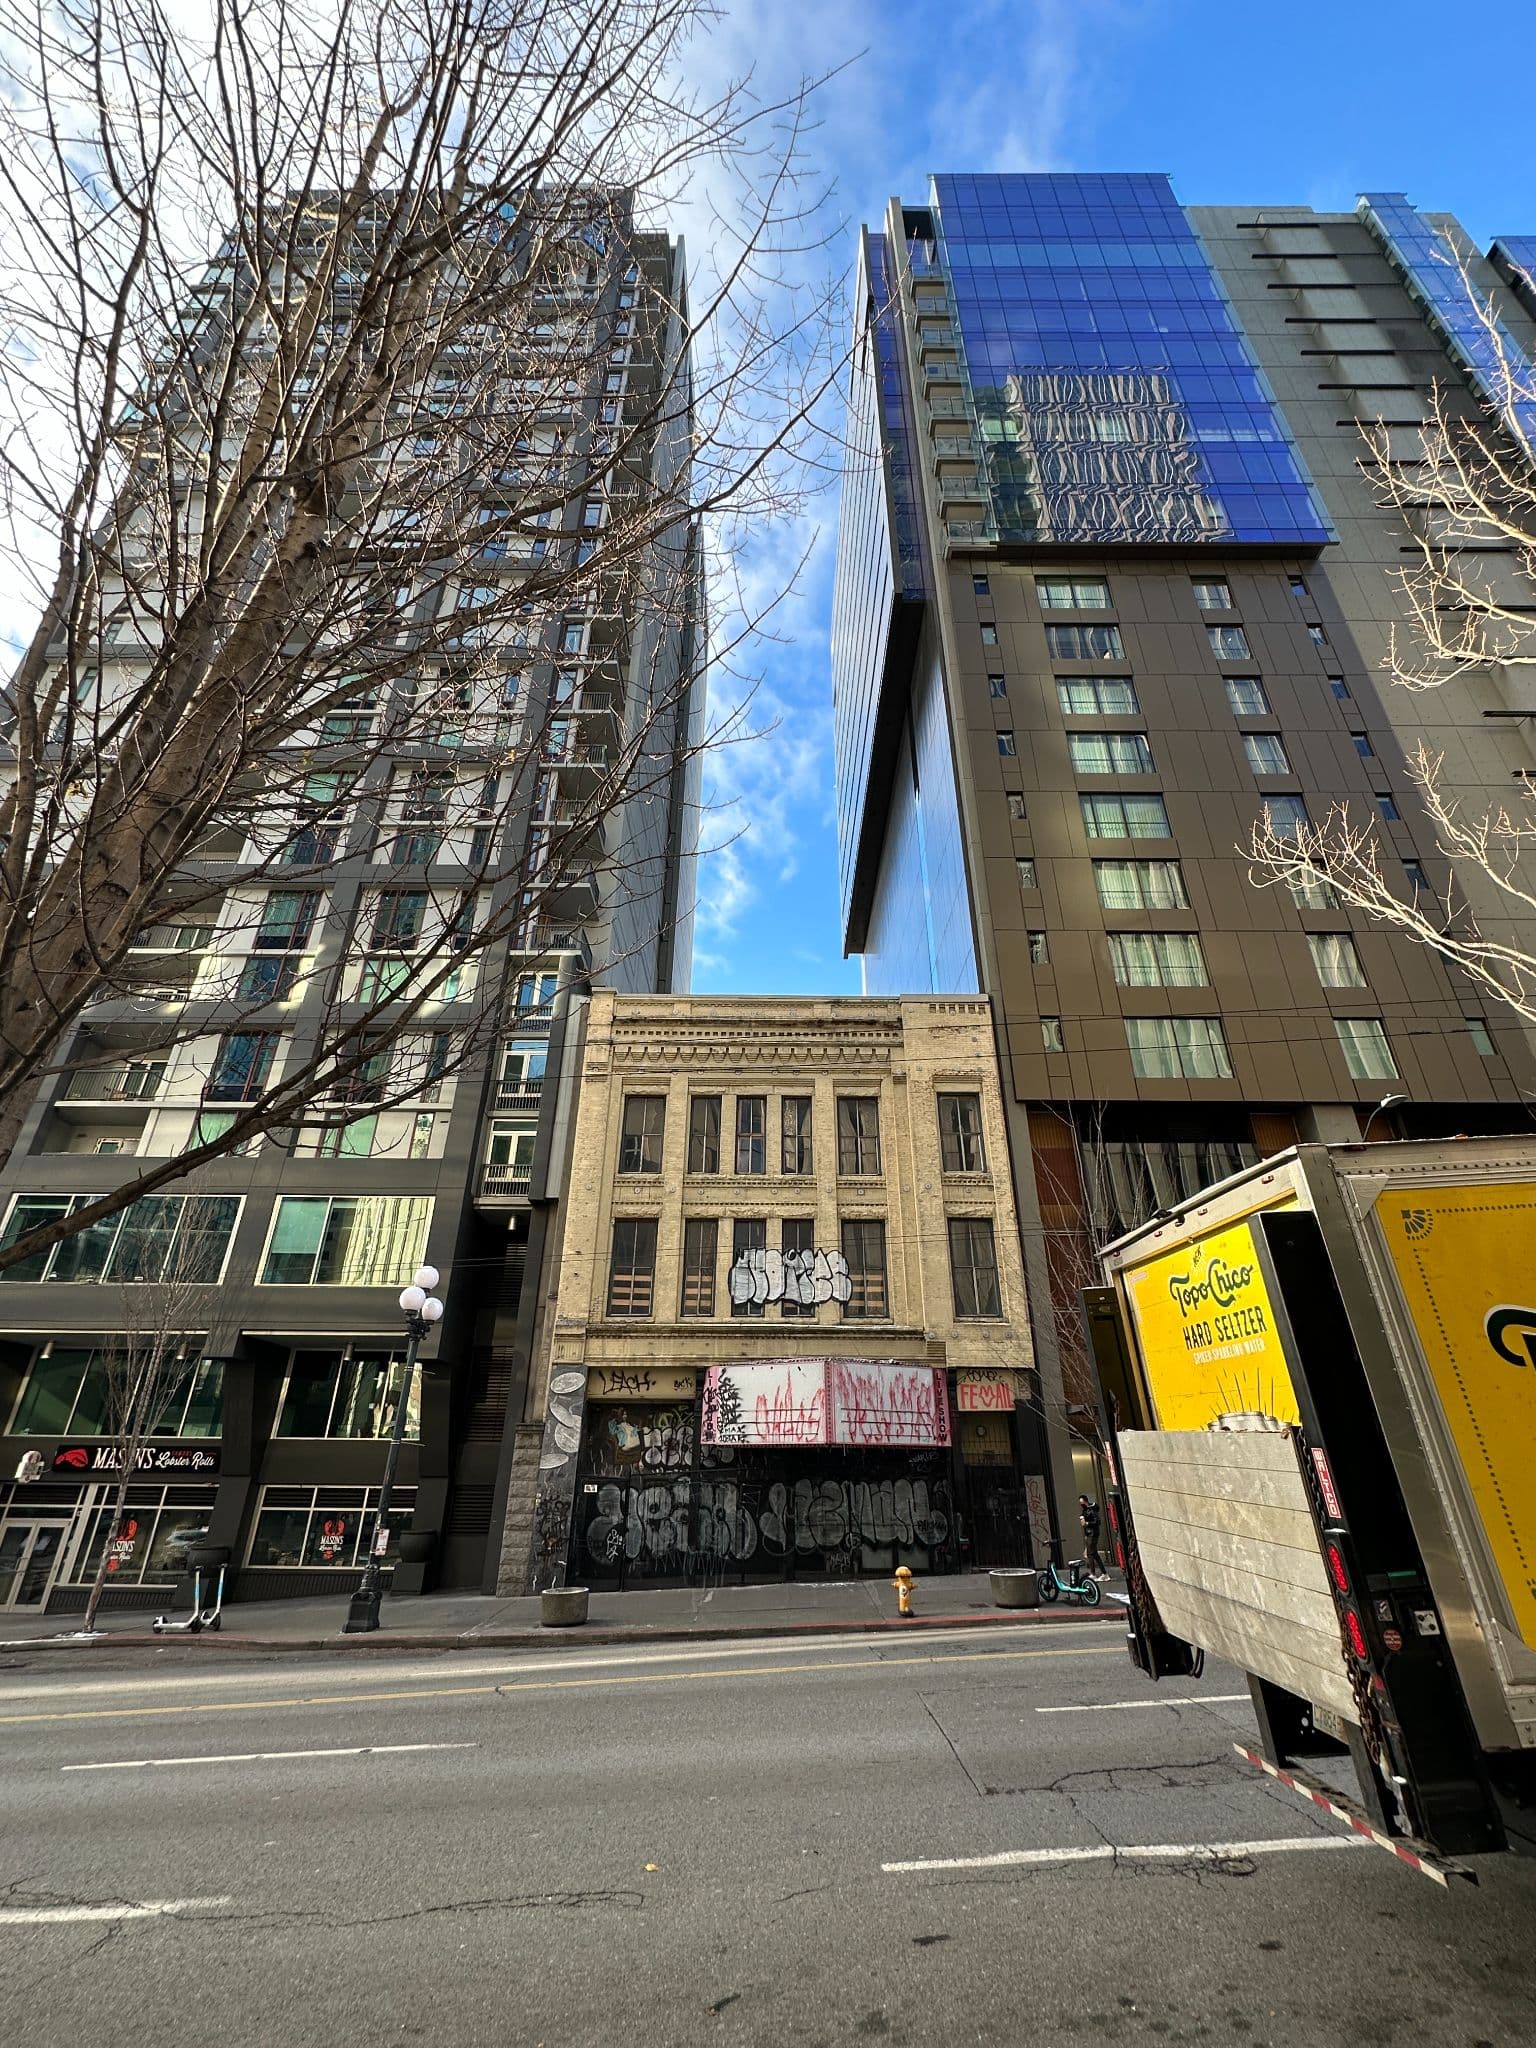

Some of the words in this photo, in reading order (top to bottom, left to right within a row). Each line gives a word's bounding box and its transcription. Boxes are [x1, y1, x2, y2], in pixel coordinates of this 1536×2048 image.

[1170, 1272, 1209, 1317] Topo
[1208, 1258, 1254, 1308] Chico
[1183, 1321, 1213, 1350] HARD
[1215, 1306, 1267, 1342] SELTZER
[155, 1451, 190, 1468] Lobster
[191, 1451, 216, 1470] Rolls
